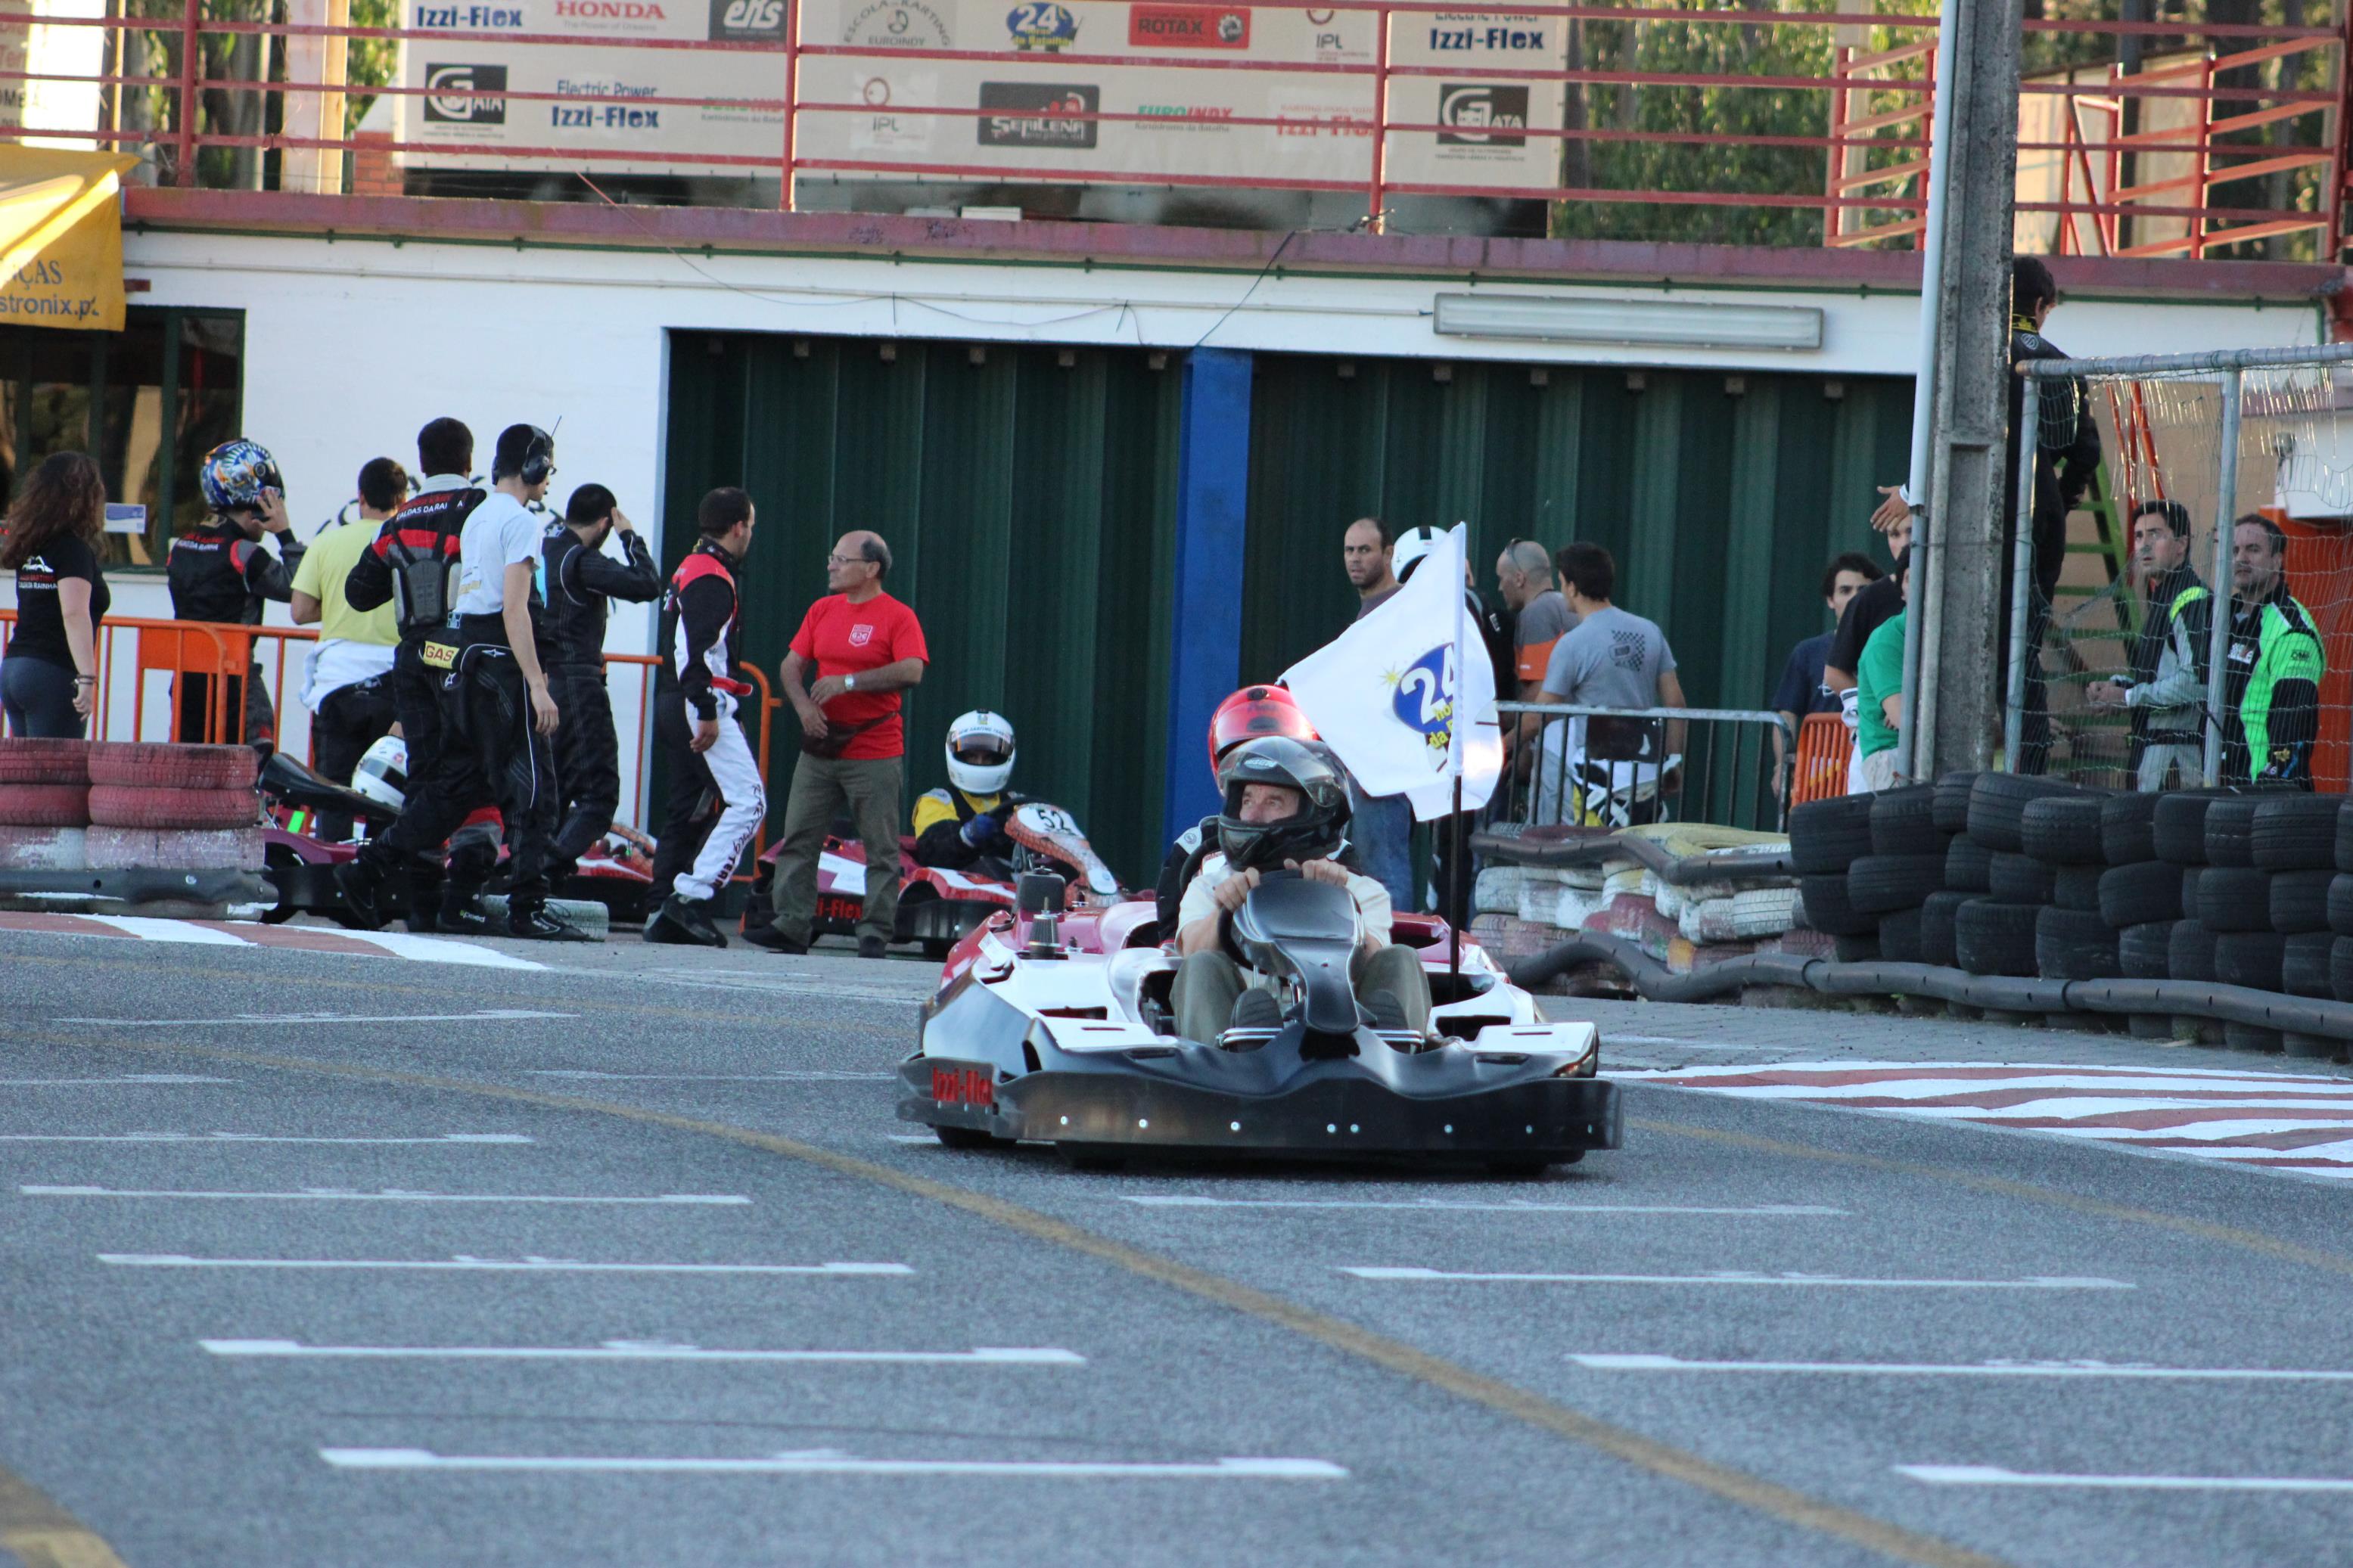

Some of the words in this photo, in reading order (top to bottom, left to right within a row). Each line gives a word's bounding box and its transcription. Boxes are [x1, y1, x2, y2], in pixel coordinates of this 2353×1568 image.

[418, 6, 523, 27] Izzi-Flex
[556, 1, 666, 20] HONDA
[1016, 5, 1058, 32] 24
[1138, 17, 1203, 34] ROTAX
[869, 36, 925, 46] EUROINDY
[1316, 33, 1343, 49] IPL
[1430, 28, 1544, 49] Izzi-Flex
[557, 80, 609, 96] Electric
[552, 105, 659, 128] Izzi-Flex
[873, 116, 899, 132] IPL
[1276, 115, 1375, 138] Izzi-Fle
[13, 260, 63, 290] ÇAS
[434, 500, 463, 511] RAIA
[425, 645, 454, 662] GAS
[1036, 809, 1072, 832] 52
